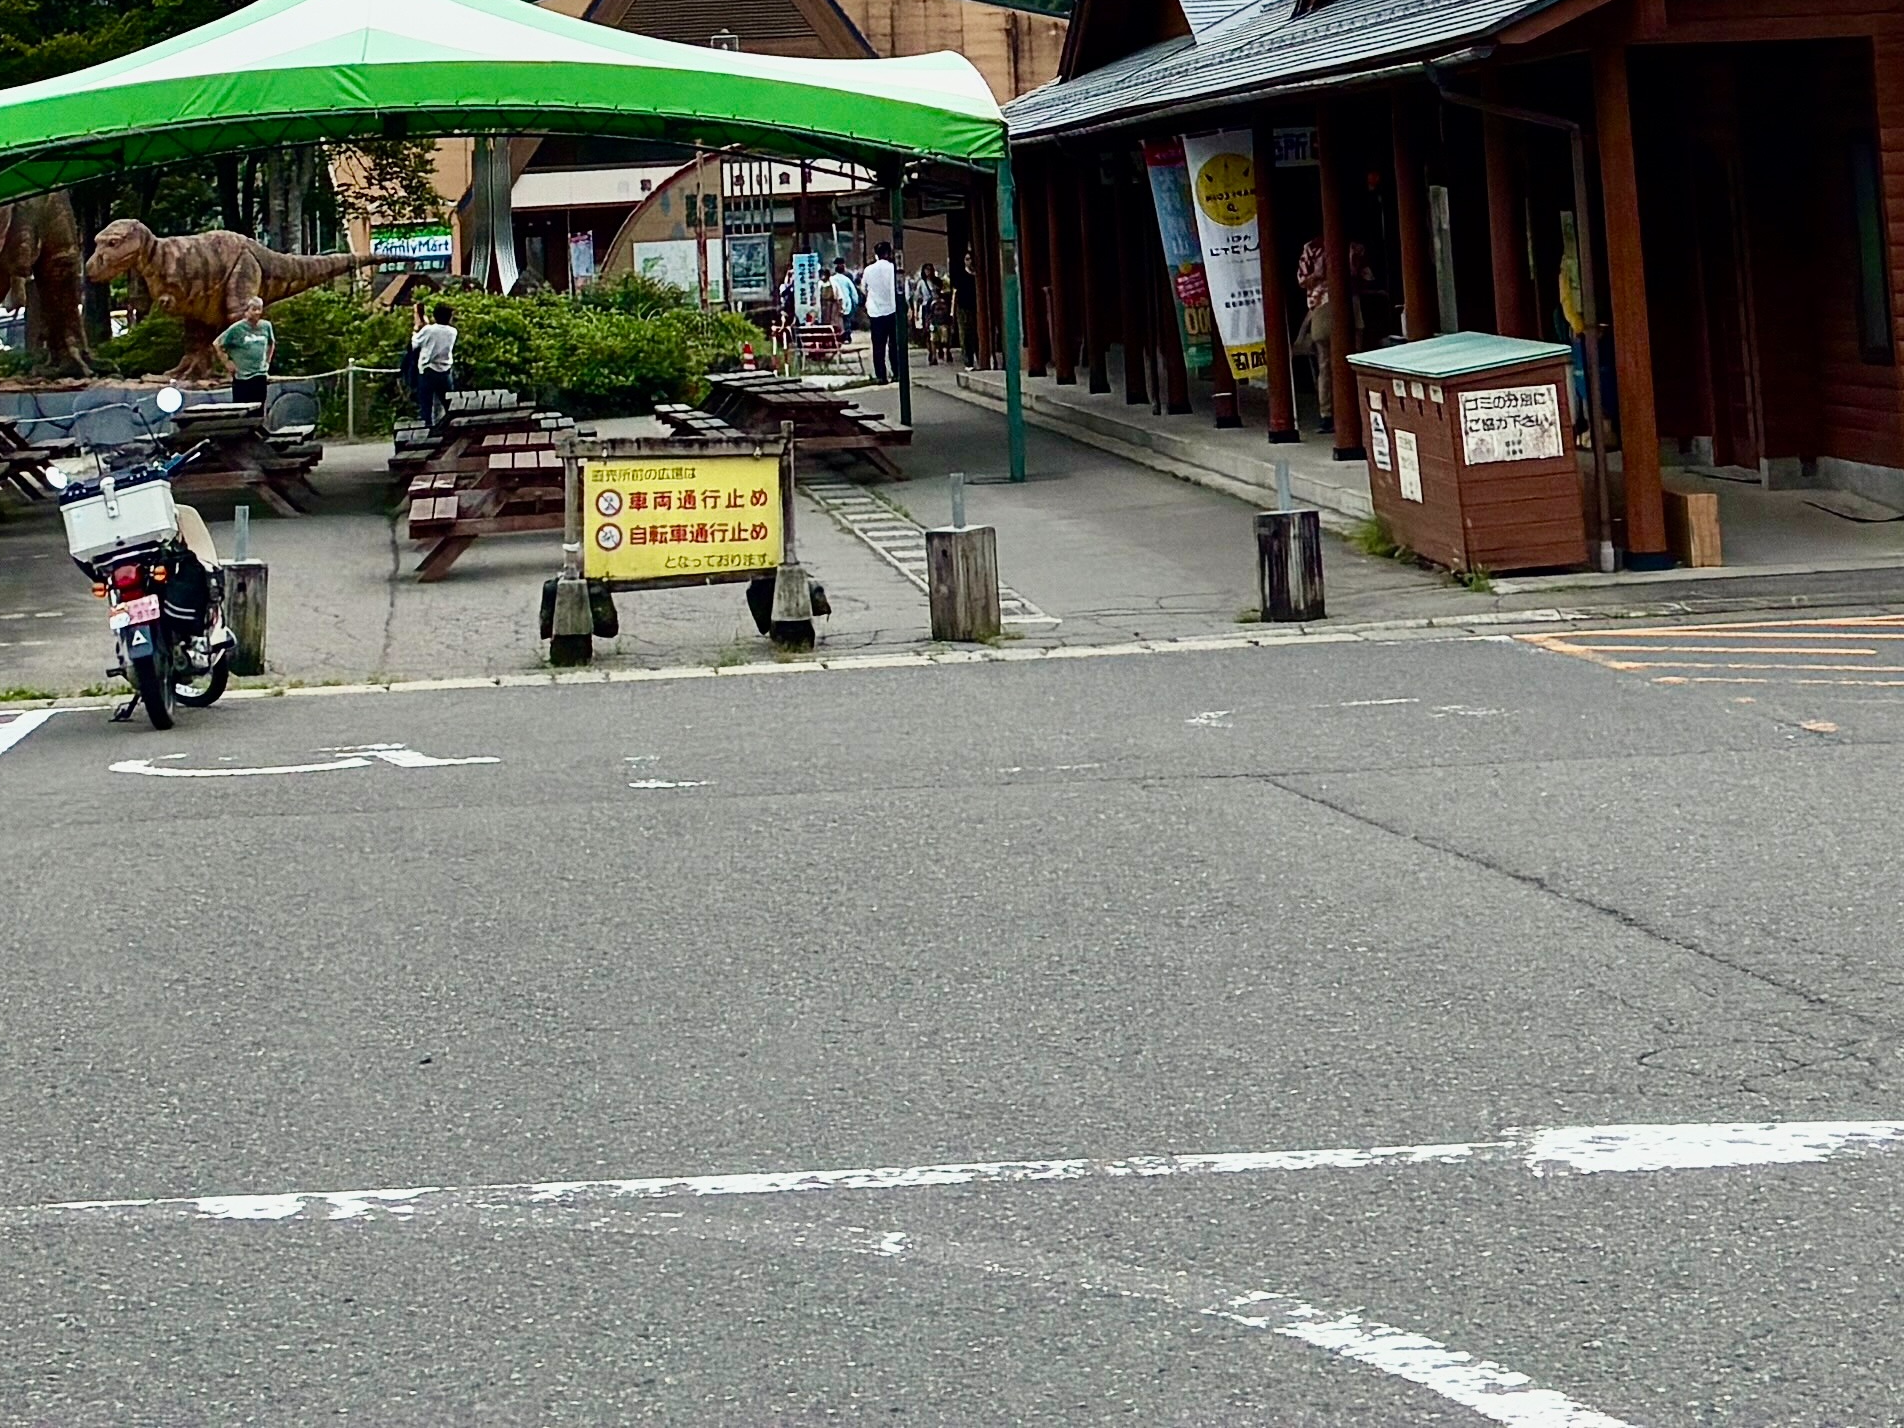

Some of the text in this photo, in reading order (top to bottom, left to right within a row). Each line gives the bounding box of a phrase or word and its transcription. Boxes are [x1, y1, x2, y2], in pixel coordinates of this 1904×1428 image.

[629, 488, 768, 511] 車両通行止め
[630, 522, 768, 545] 自転車通行止め
[665, 554, 775, 569] となっております。
